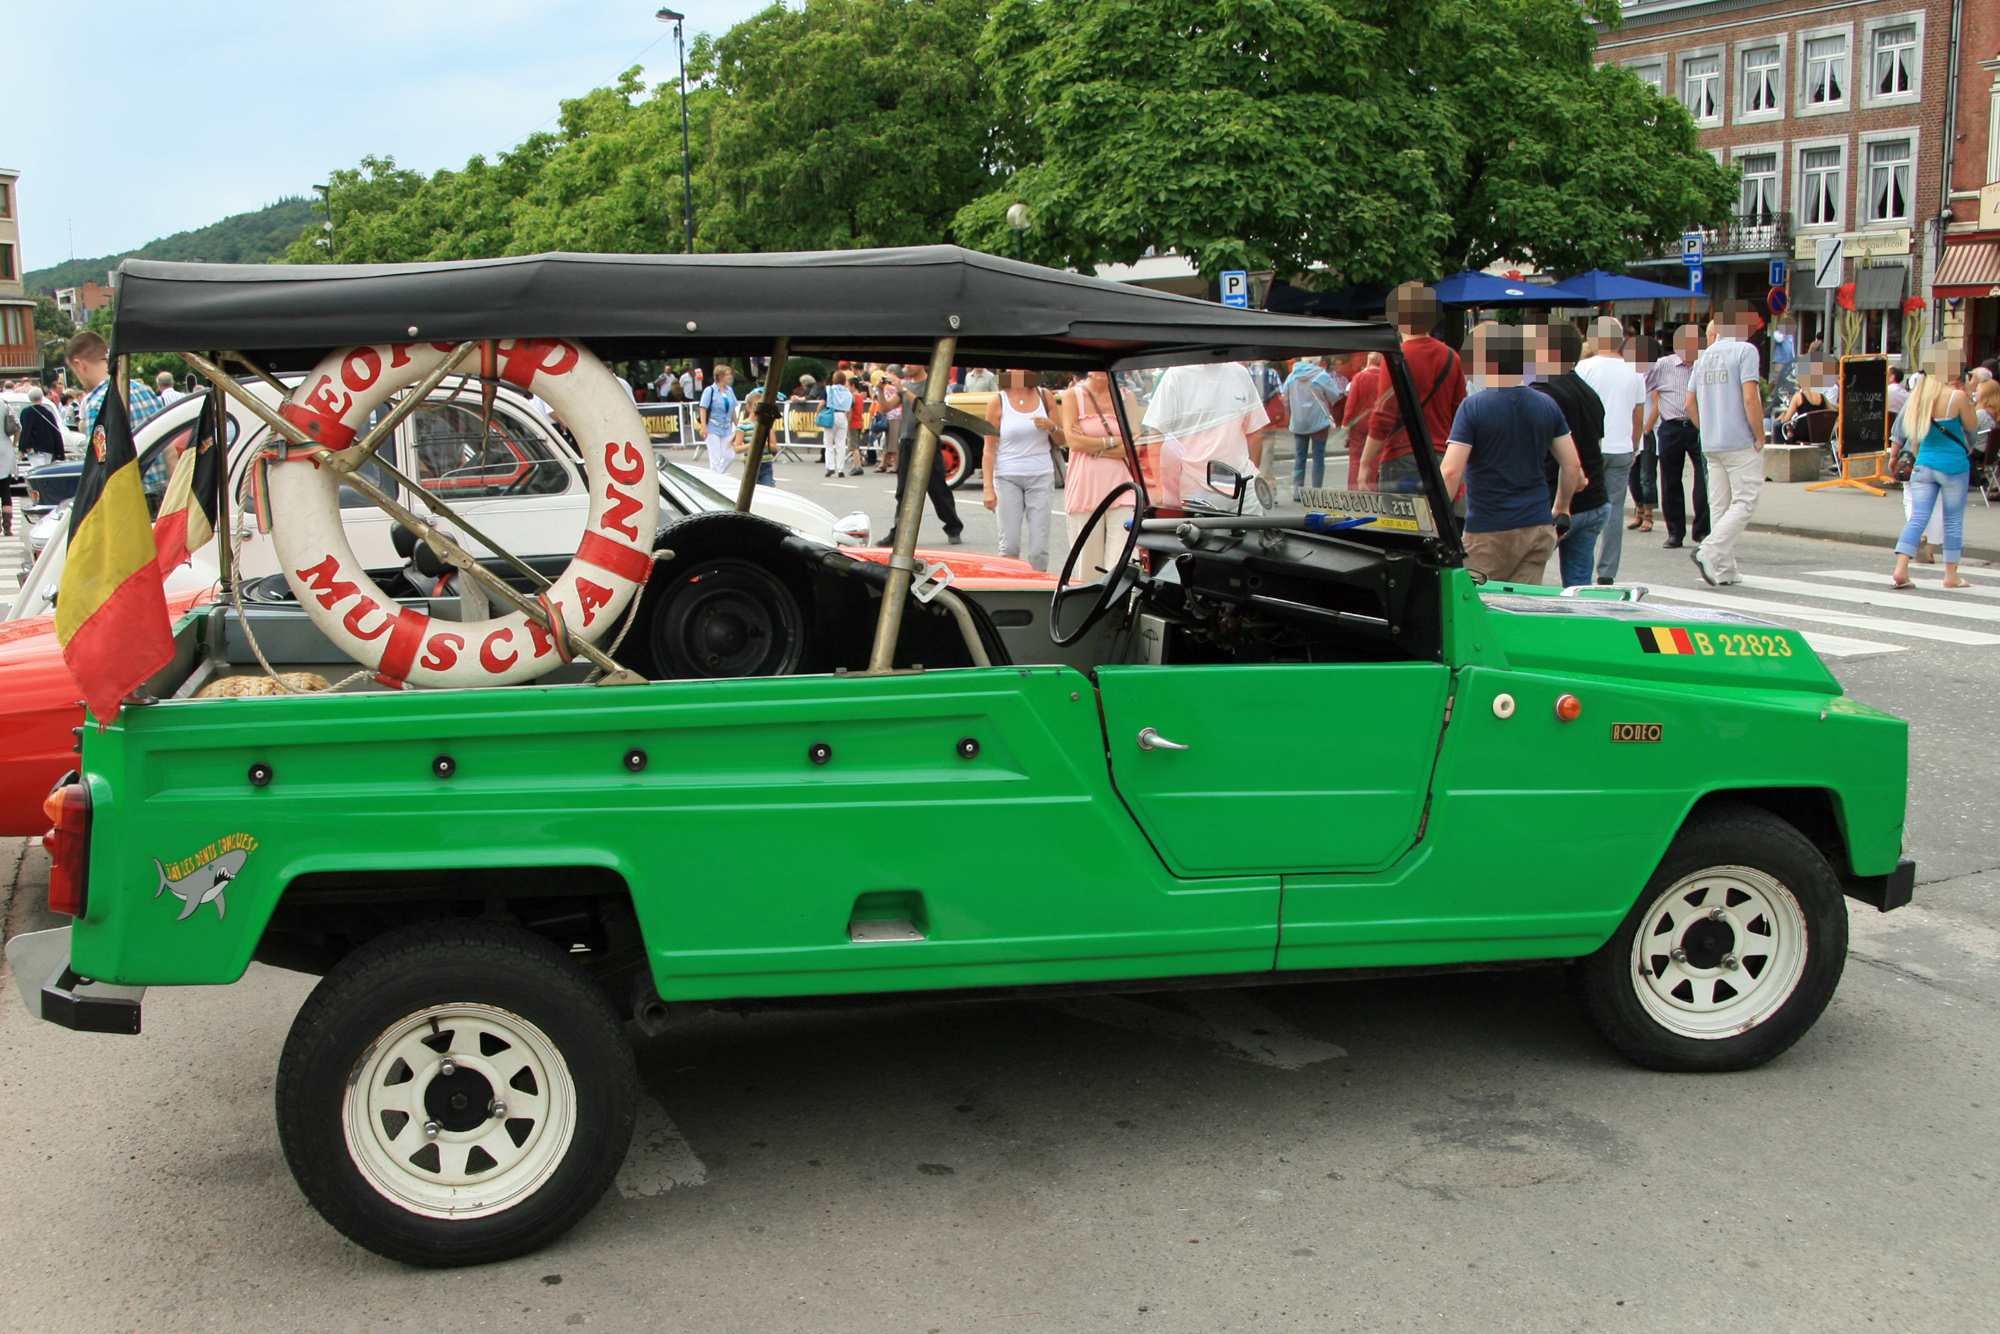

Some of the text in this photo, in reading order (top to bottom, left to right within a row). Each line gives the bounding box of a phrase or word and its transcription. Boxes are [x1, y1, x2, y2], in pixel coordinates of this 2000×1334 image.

[1687, 240, 1697, 253] P
[1229, 277, 1240, 294] P
[1691, 270, 1703, 292] P
[1693, 632, 1793, 658] B 22823
[181, 857, 196, 877] LES
[194, 843, 218, 867] DENTS
